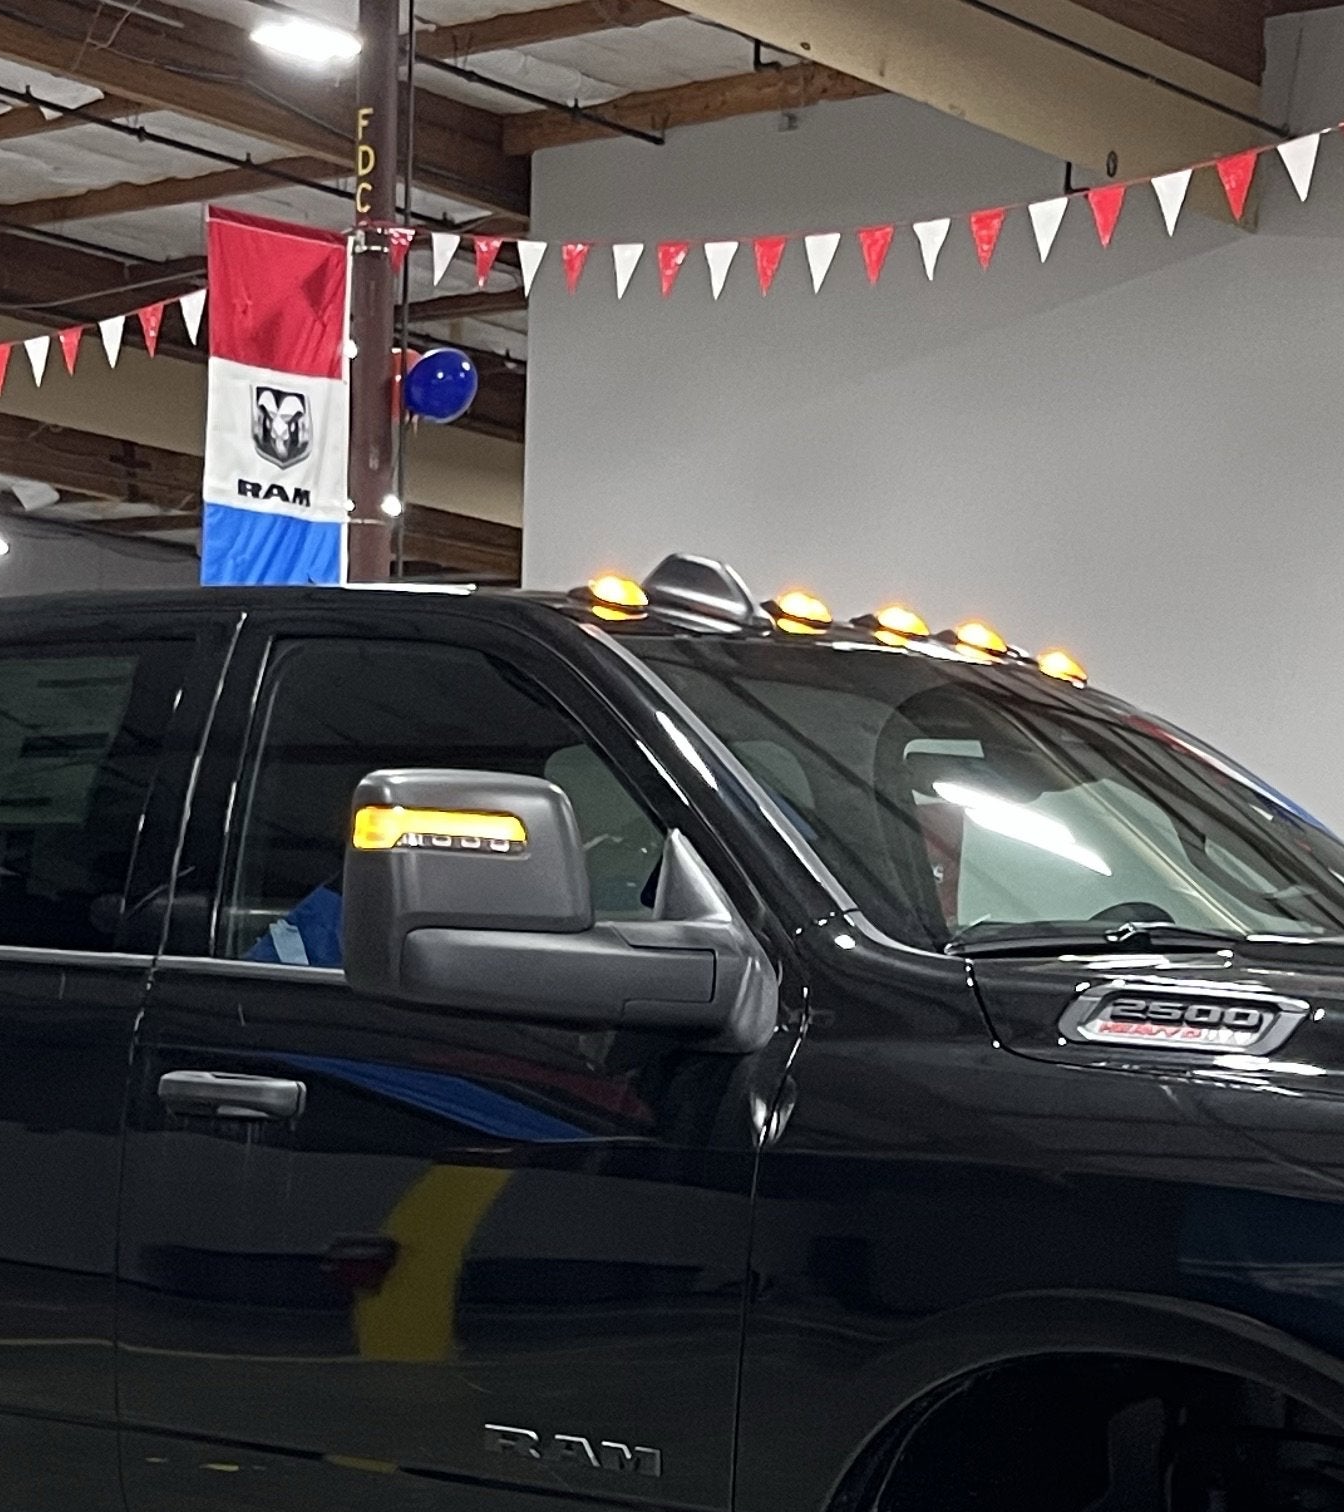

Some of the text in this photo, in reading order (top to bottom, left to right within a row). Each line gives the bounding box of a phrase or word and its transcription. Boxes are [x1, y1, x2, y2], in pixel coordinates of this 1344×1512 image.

[237, 478, 311, 508] RAM
[1109, 998, 1264, 1034] 2500
[484, 1423, 662, 1478] RAM
